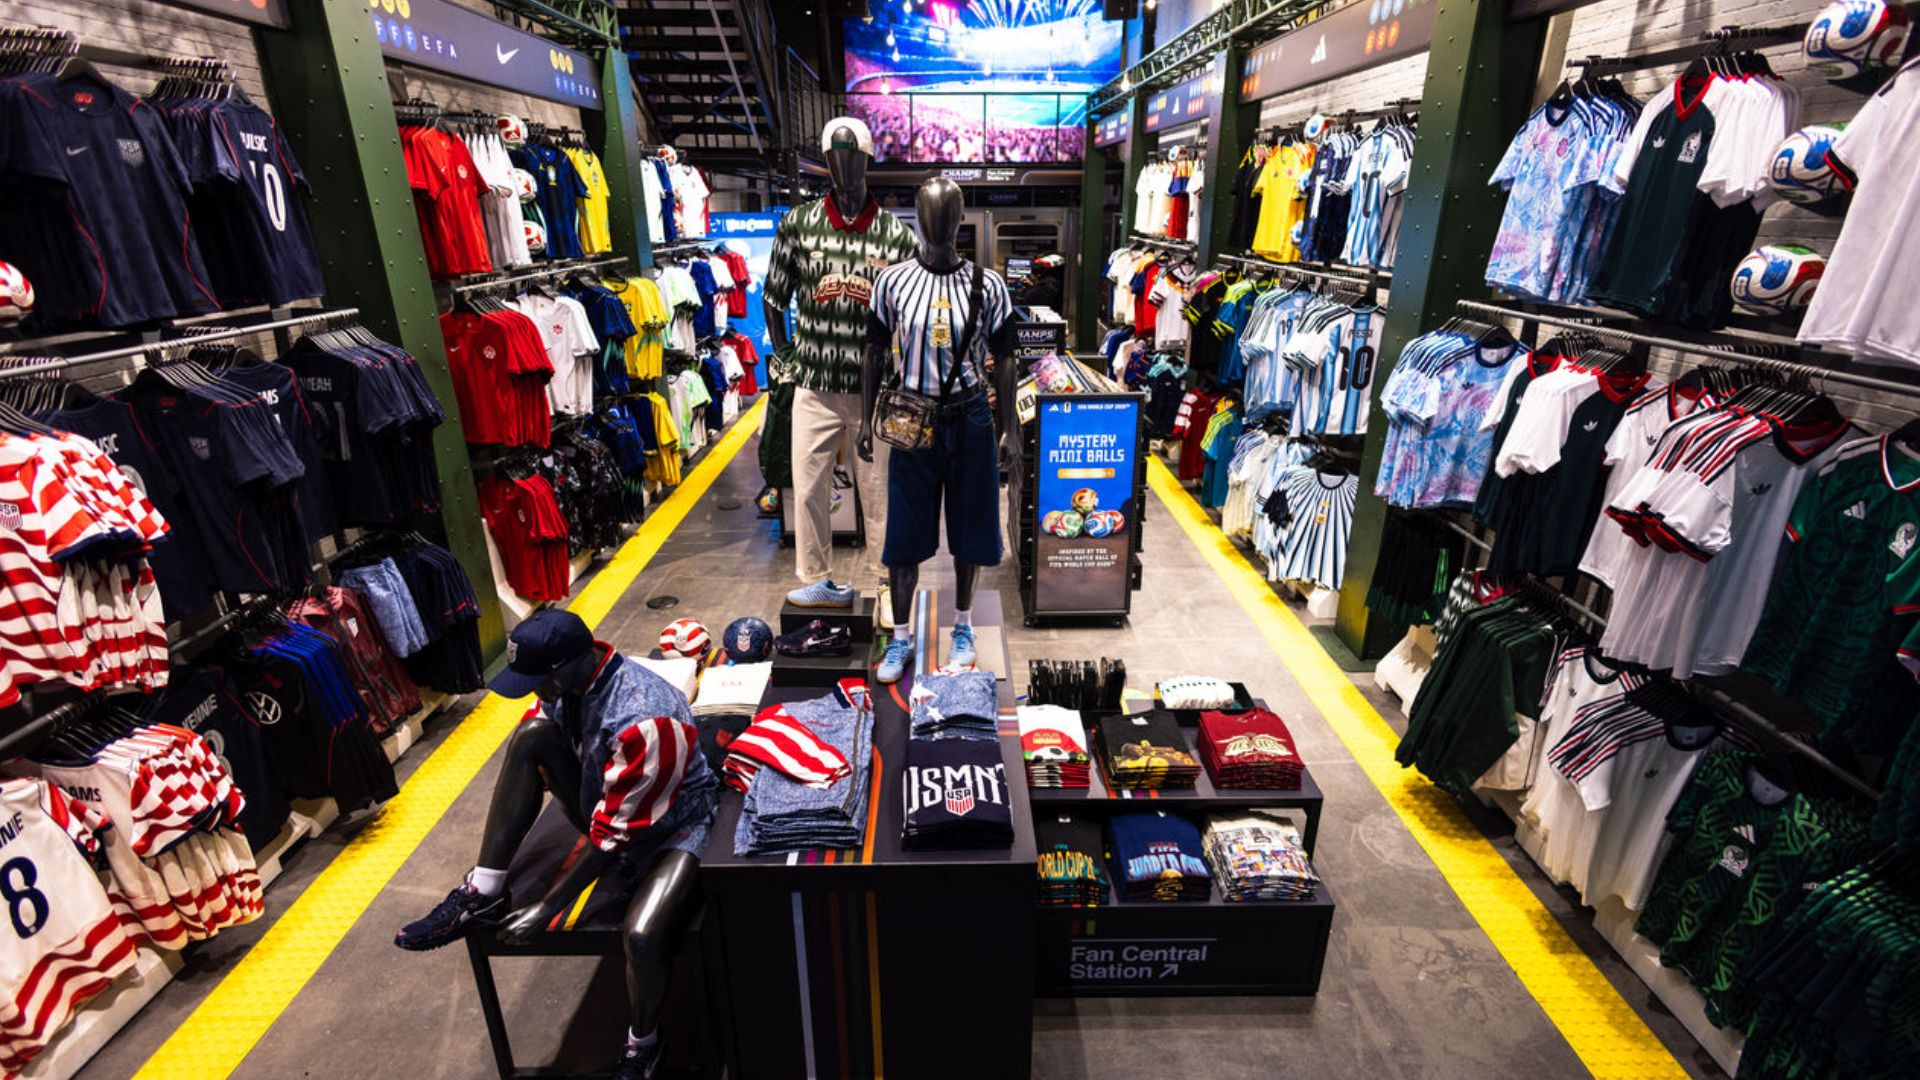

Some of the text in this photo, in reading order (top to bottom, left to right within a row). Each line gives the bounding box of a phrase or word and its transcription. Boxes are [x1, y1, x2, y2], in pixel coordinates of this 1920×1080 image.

[1017, 329, 1057, 340] HAMPS
[1339, 345, 1375, 391] 10
[1059, 434, 1117, 448] MYSTERY
[1049, 449, 1125, 463] MINI BALLS
[946, 789, 972, 800] USA
[0, 857, 49, 939] 8
[1071, 945, 1207, 962] Fan Central
[1070, 963, 1152, 979] Station
